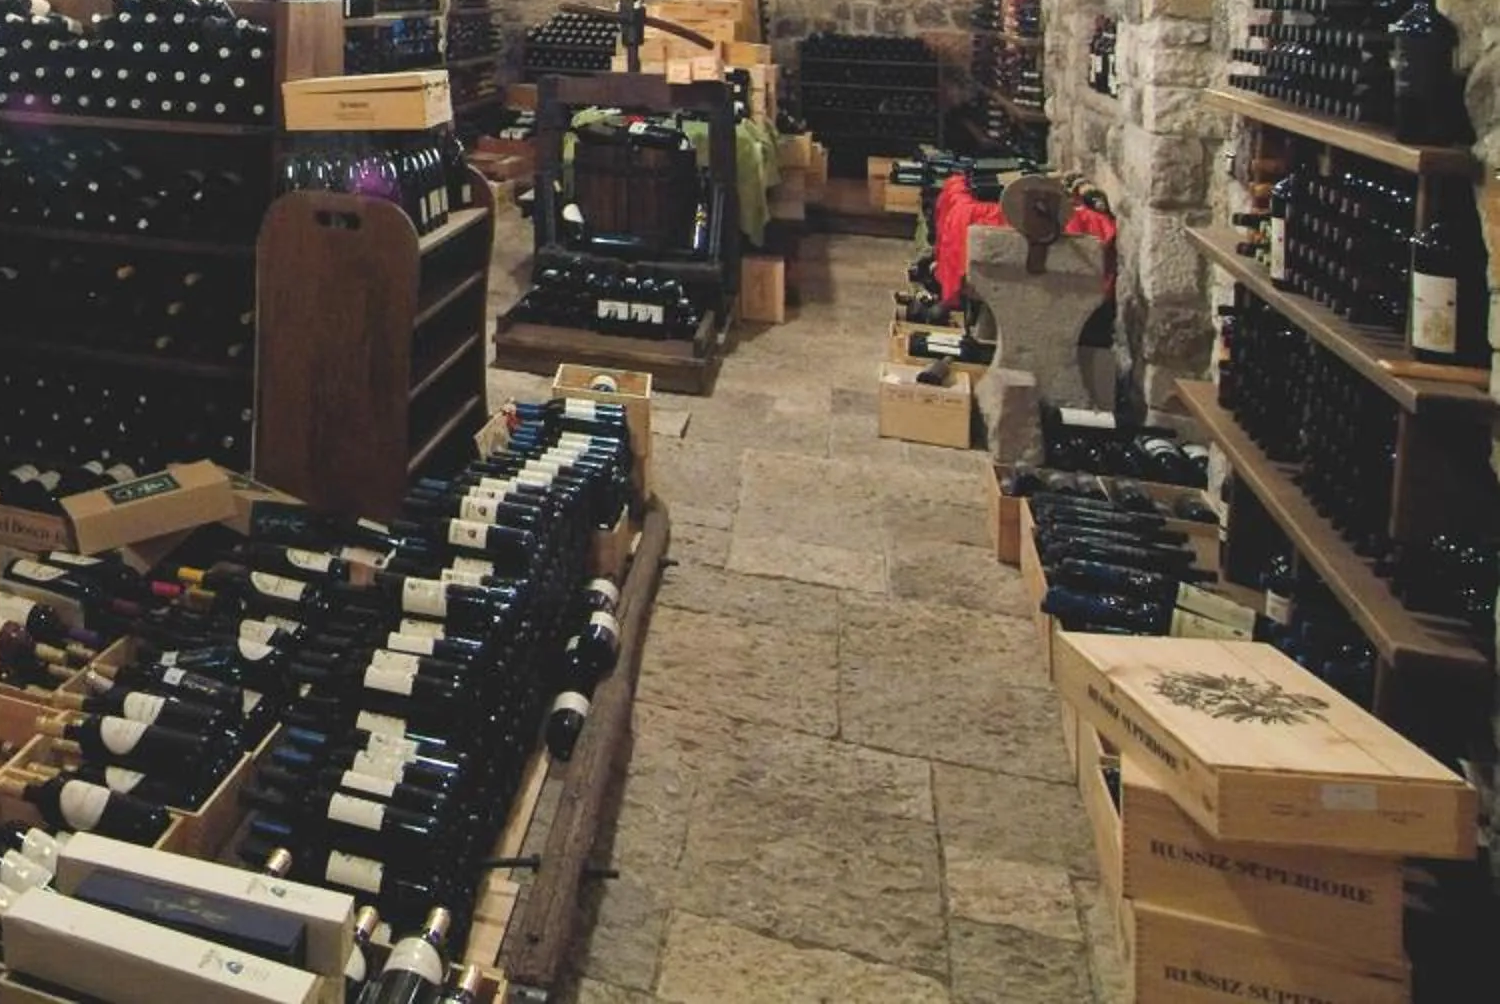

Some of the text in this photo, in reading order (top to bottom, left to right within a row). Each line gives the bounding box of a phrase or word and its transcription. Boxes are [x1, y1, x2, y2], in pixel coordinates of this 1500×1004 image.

[1149, 838, 1374, 905] RUSSIZ SUPERIORE
[1164, 965, 1243, 996] RUSSIZ
